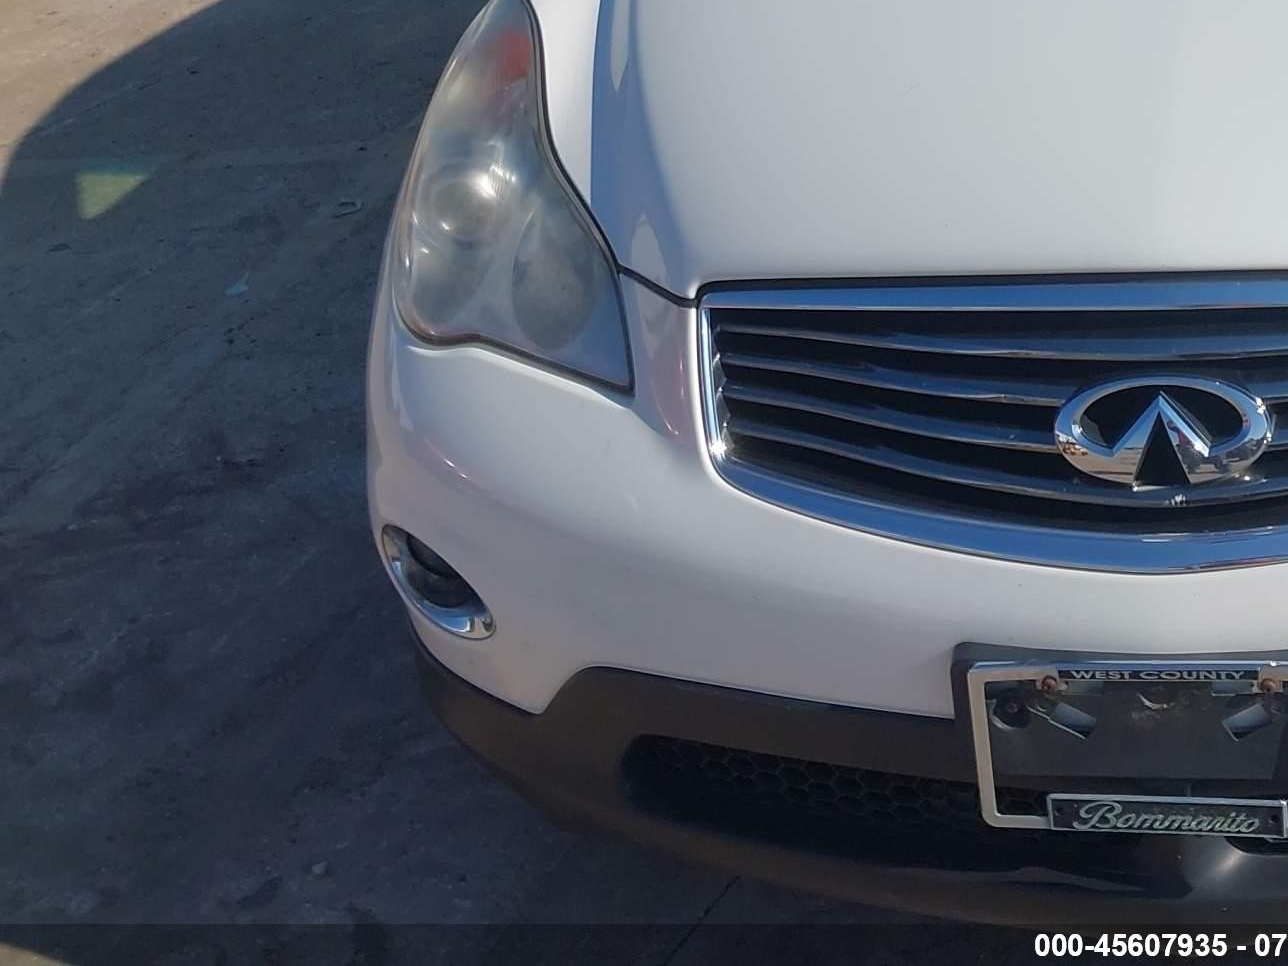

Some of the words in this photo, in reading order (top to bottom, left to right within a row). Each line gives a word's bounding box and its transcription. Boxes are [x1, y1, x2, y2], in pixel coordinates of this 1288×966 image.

[1070, 670, 1133, 680] WEST
[1139, 670, 1245, 680] COUNTY
[1072, 800, 1261, 833] Bommarito
